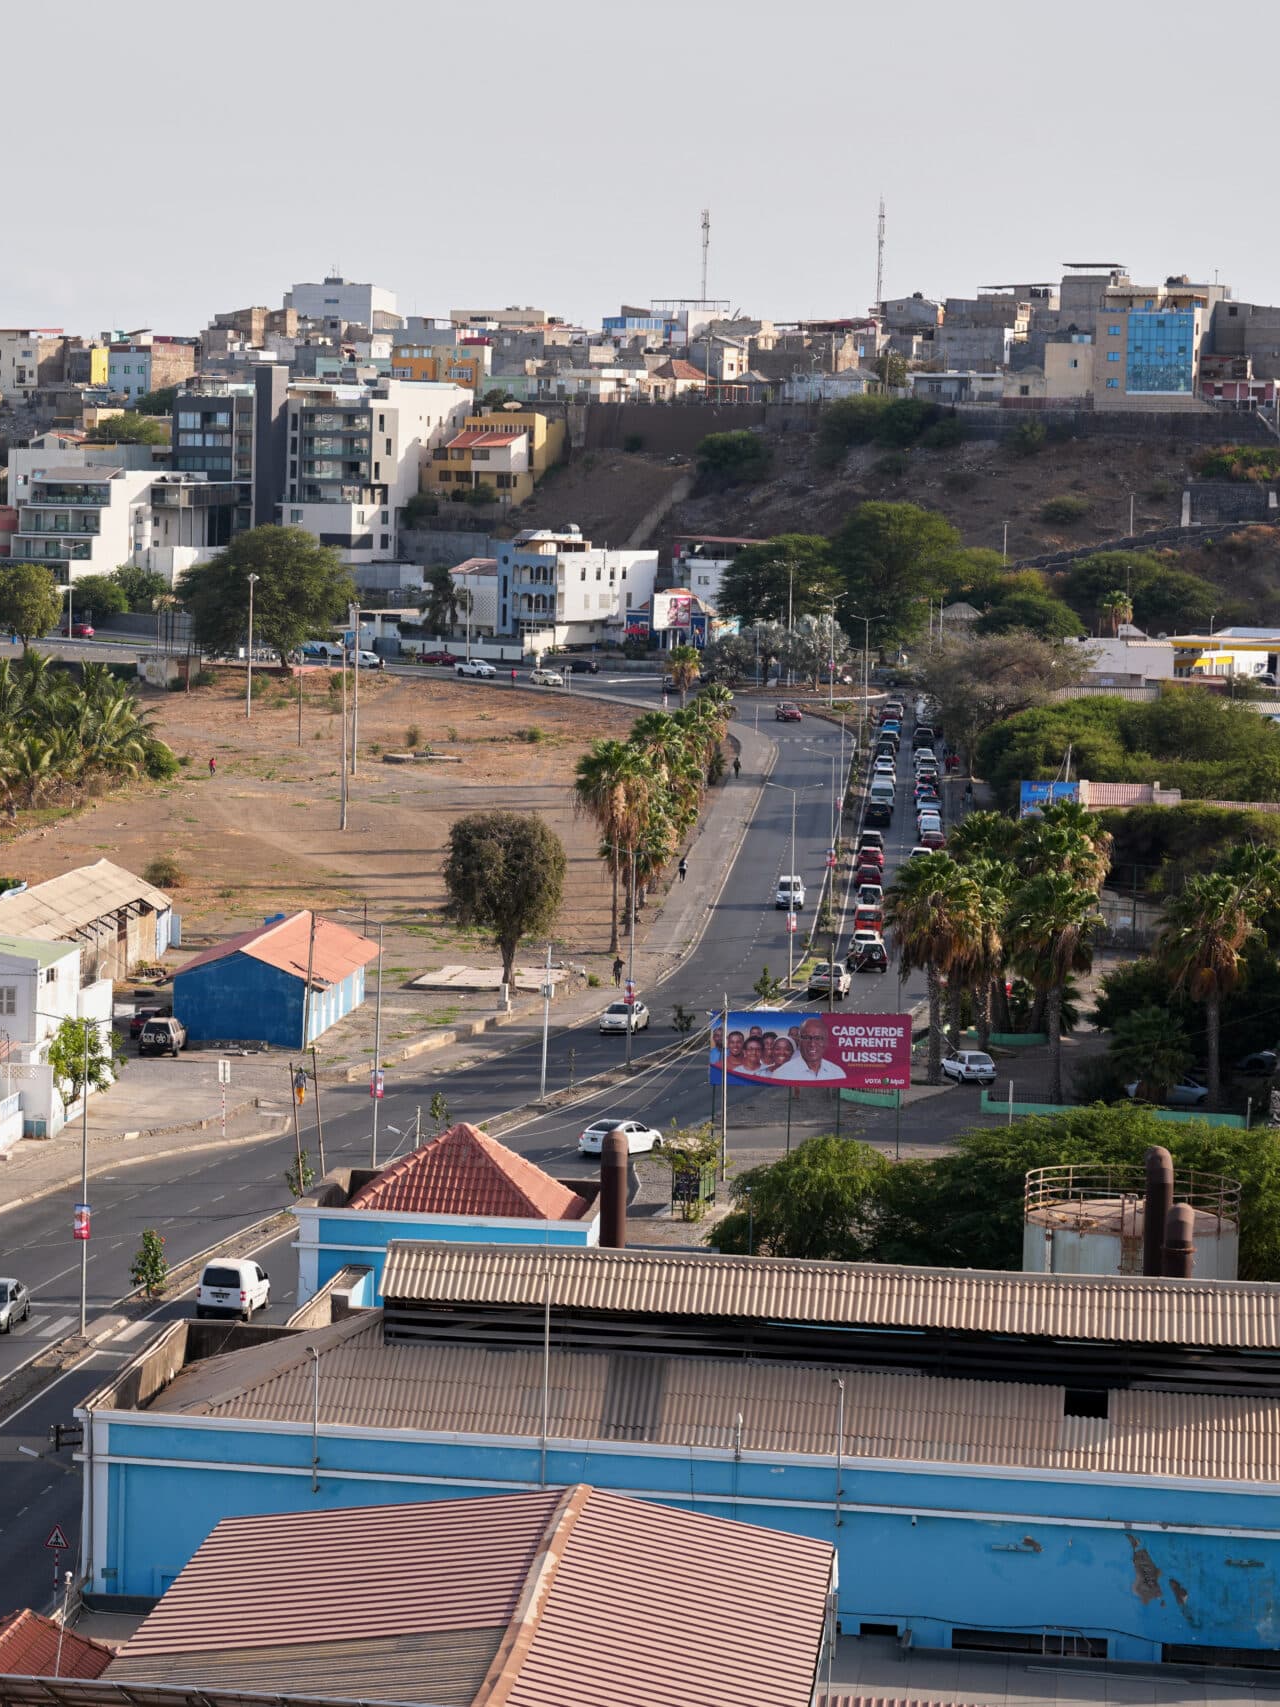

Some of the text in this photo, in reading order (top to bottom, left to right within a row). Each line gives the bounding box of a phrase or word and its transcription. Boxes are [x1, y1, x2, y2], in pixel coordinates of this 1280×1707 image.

[832, 1026, 904, 1037] CABO VERDE
[839, 1037, 897, 1048] PA FRENTE
[842, 1051, 893, 1063] ULISSES
